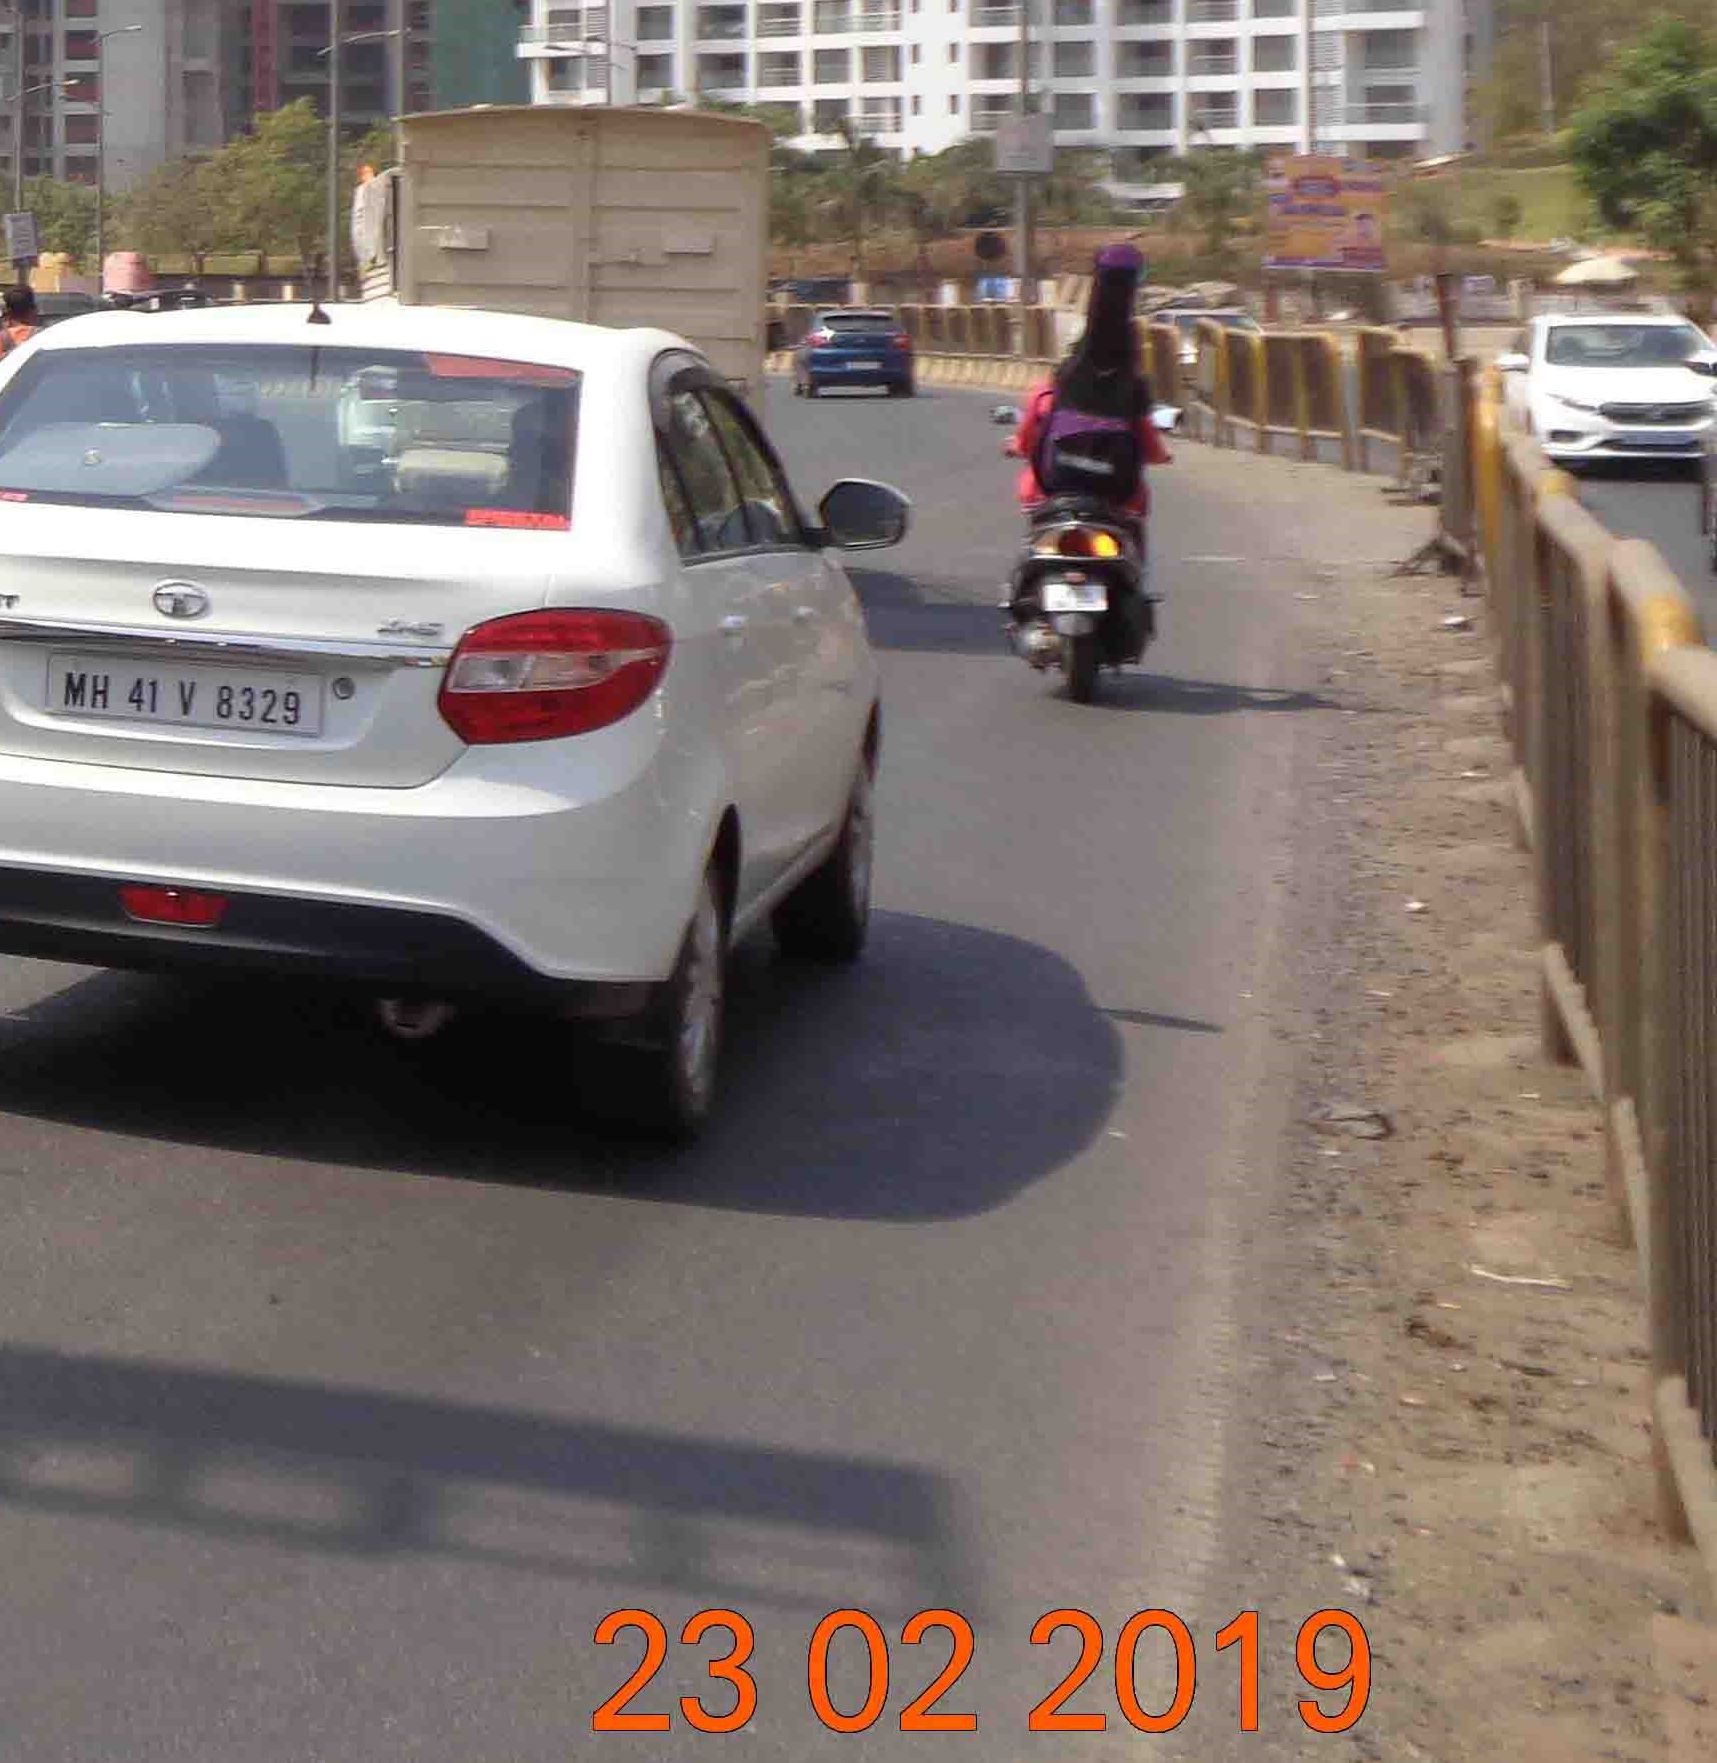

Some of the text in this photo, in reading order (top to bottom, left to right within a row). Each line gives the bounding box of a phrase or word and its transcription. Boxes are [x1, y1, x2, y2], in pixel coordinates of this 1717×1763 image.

[65, 672, 301, 725] MH 41 V 8329
